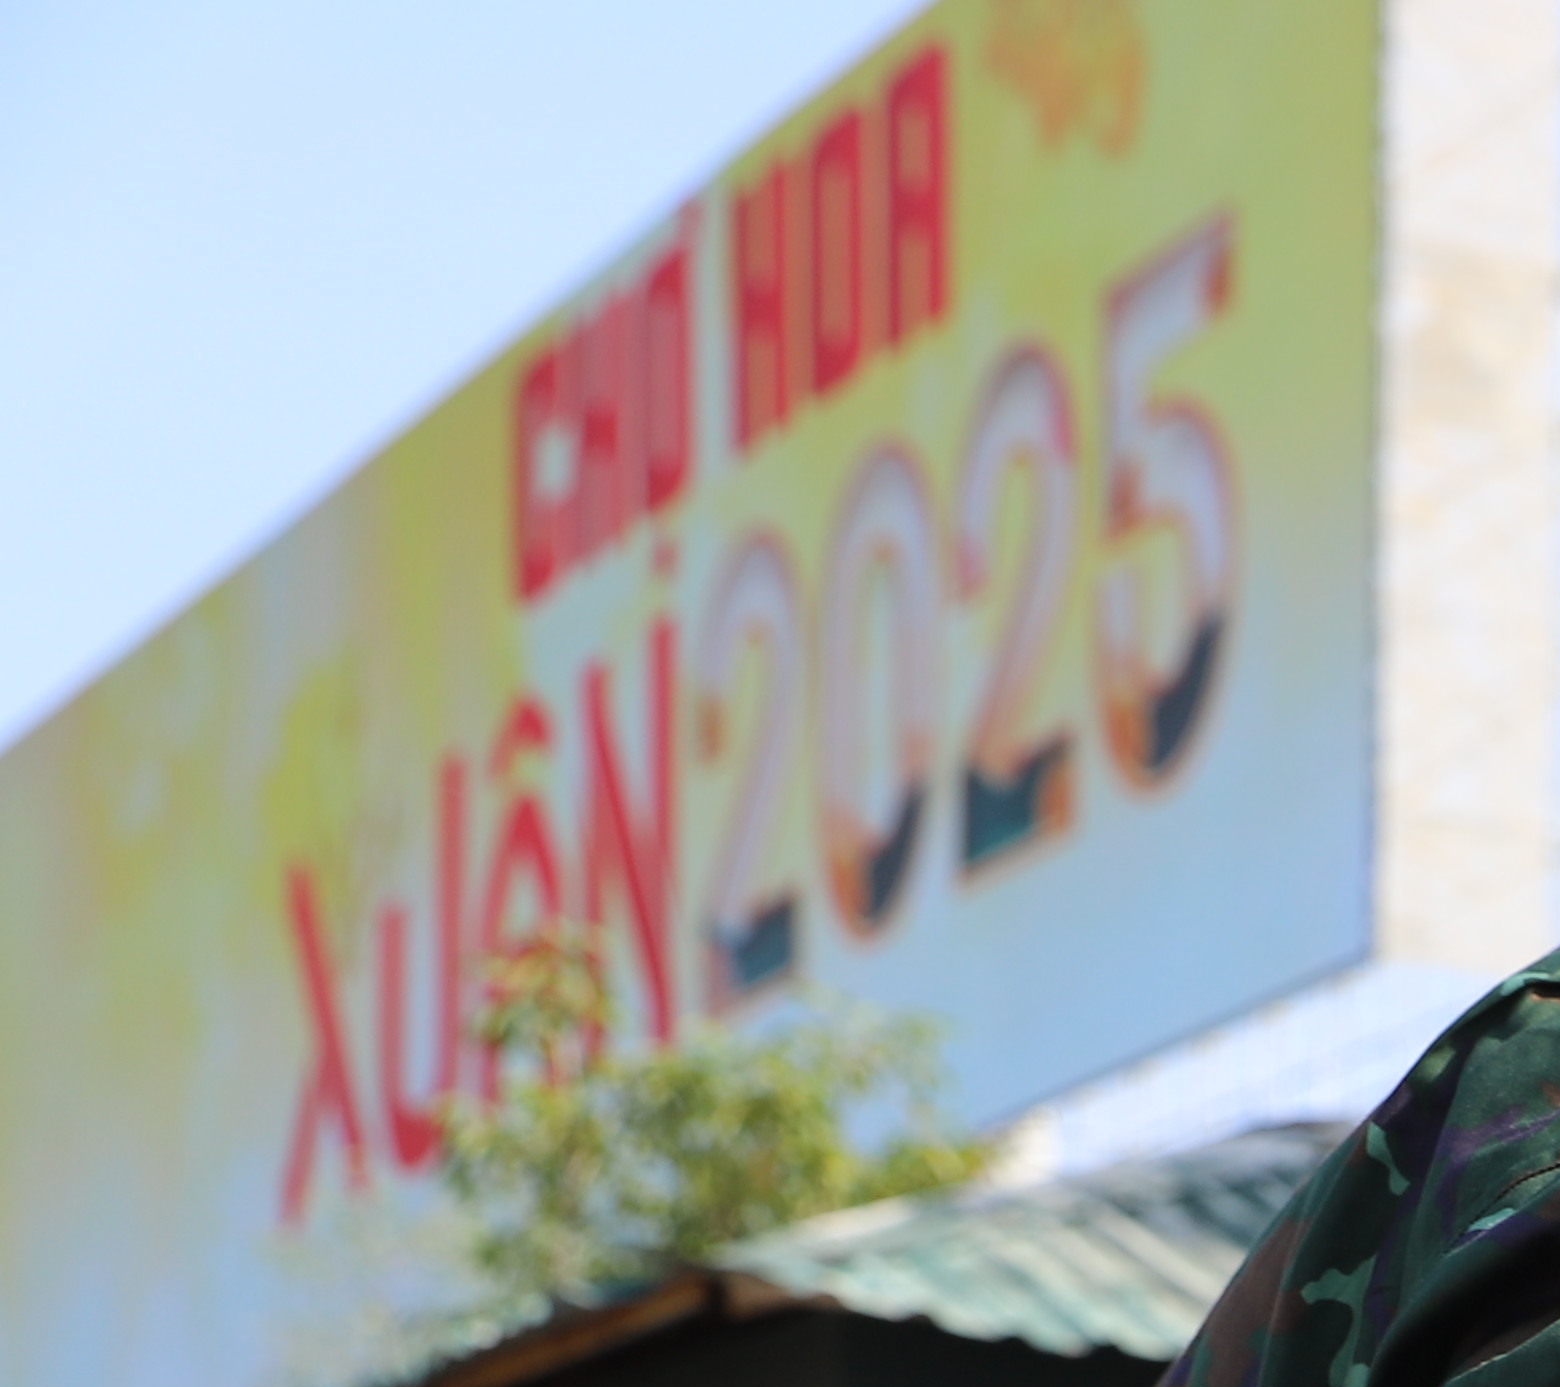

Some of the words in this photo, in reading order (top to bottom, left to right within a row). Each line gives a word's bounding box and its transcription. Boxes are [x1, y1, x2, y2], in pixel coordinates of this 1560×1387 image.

[732, 40, 949, 466] HOA
[276, 614, 676, 1230] XUÂN
[698, 205, 1240, 1012] 2025
